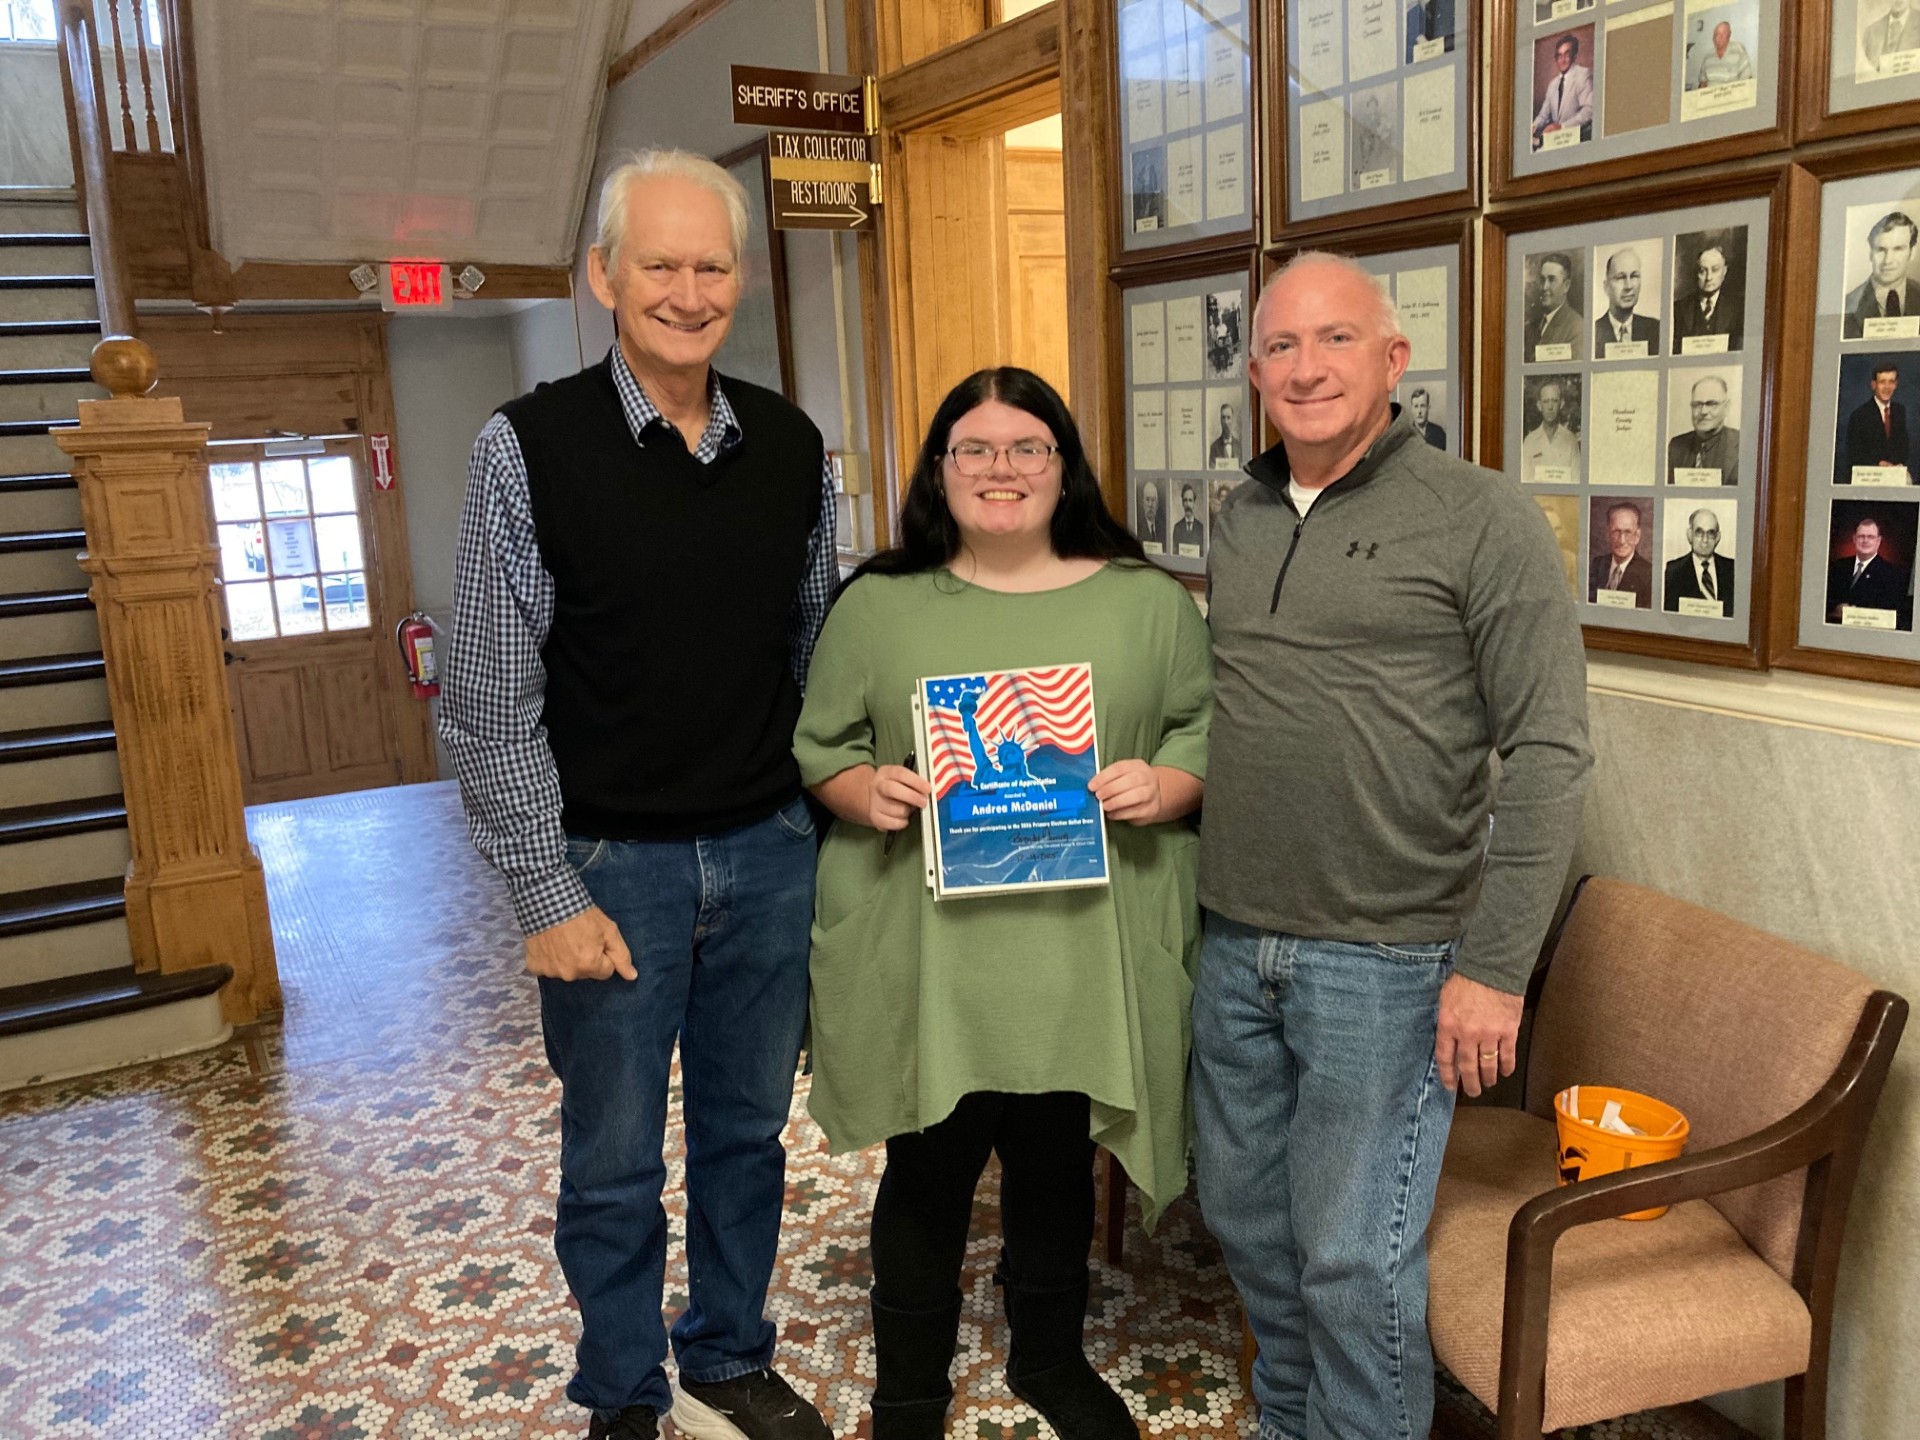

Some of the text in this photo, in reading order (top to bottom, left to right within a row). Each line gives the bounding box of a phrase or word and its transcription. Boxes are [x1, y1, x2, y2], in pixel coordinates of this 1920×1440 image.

[738, 84, 860, 114] SHERIFF'S OFFICE
[776, 134, 867, 161] TAX COLLECTOR
[791, 181, 857, 206] RESTROOMS
[391, 264, 442, 305] EXIT
[373, 440, 387, 448] FIRE
[980, 778, 1056, 790] Certificate of Appreciation
[972, 798, 1057, 816] Andrea McDaniel
[979, 824, 1007, 833] participating
